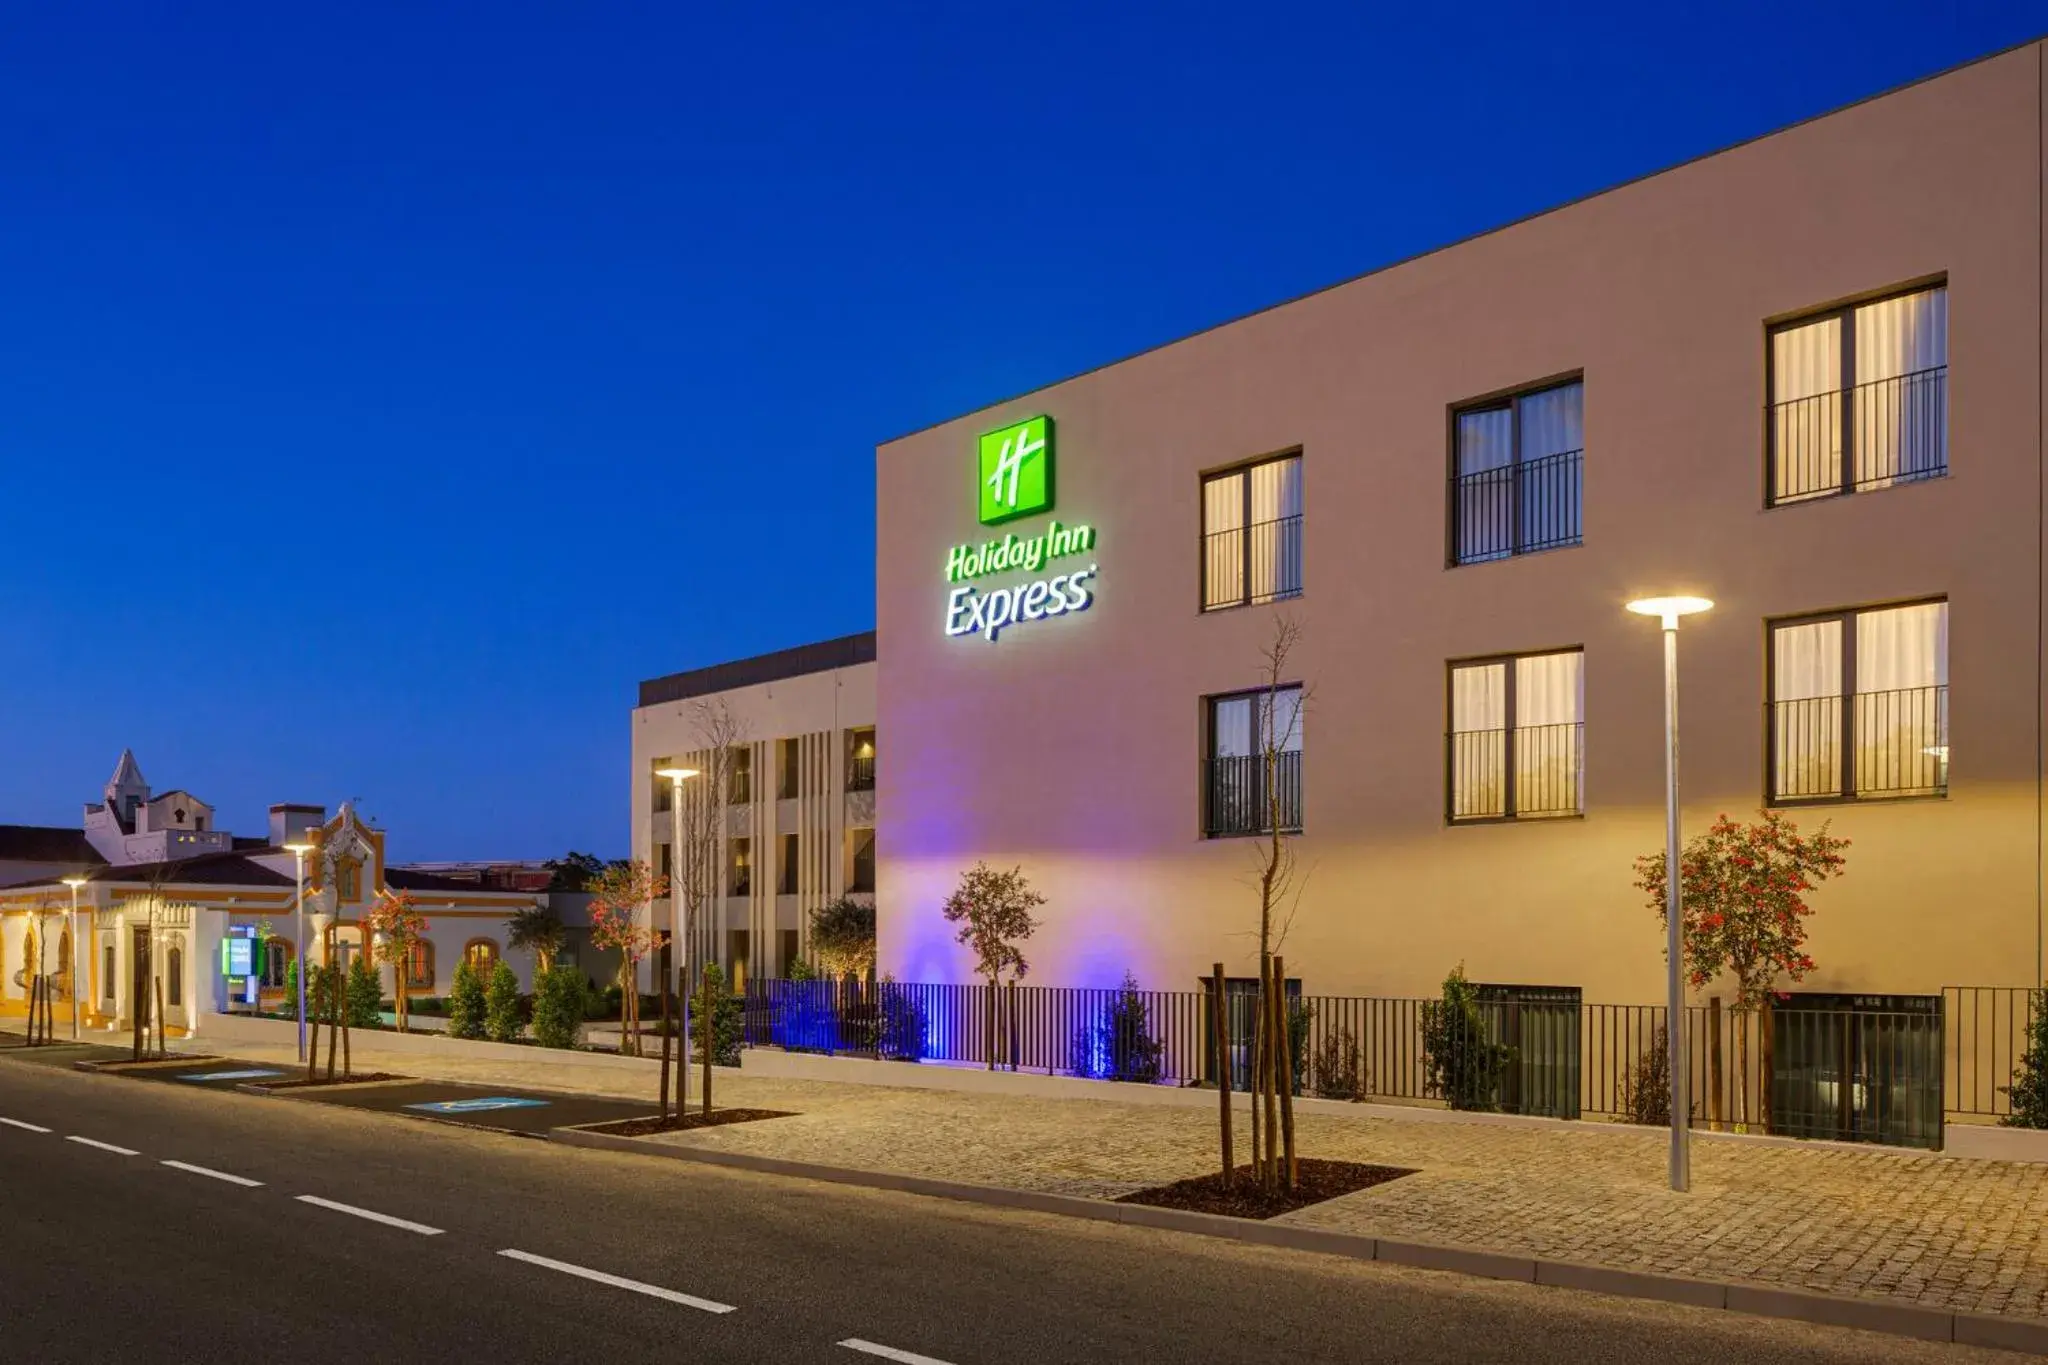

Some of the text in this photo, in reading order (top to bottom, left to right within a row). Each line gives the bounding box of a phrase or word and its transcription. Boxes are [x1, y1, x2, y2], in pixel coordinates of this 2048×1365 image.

[945, 521, 1090, 581] Holiday Inn
[945, 569, 1089, 641] Express
